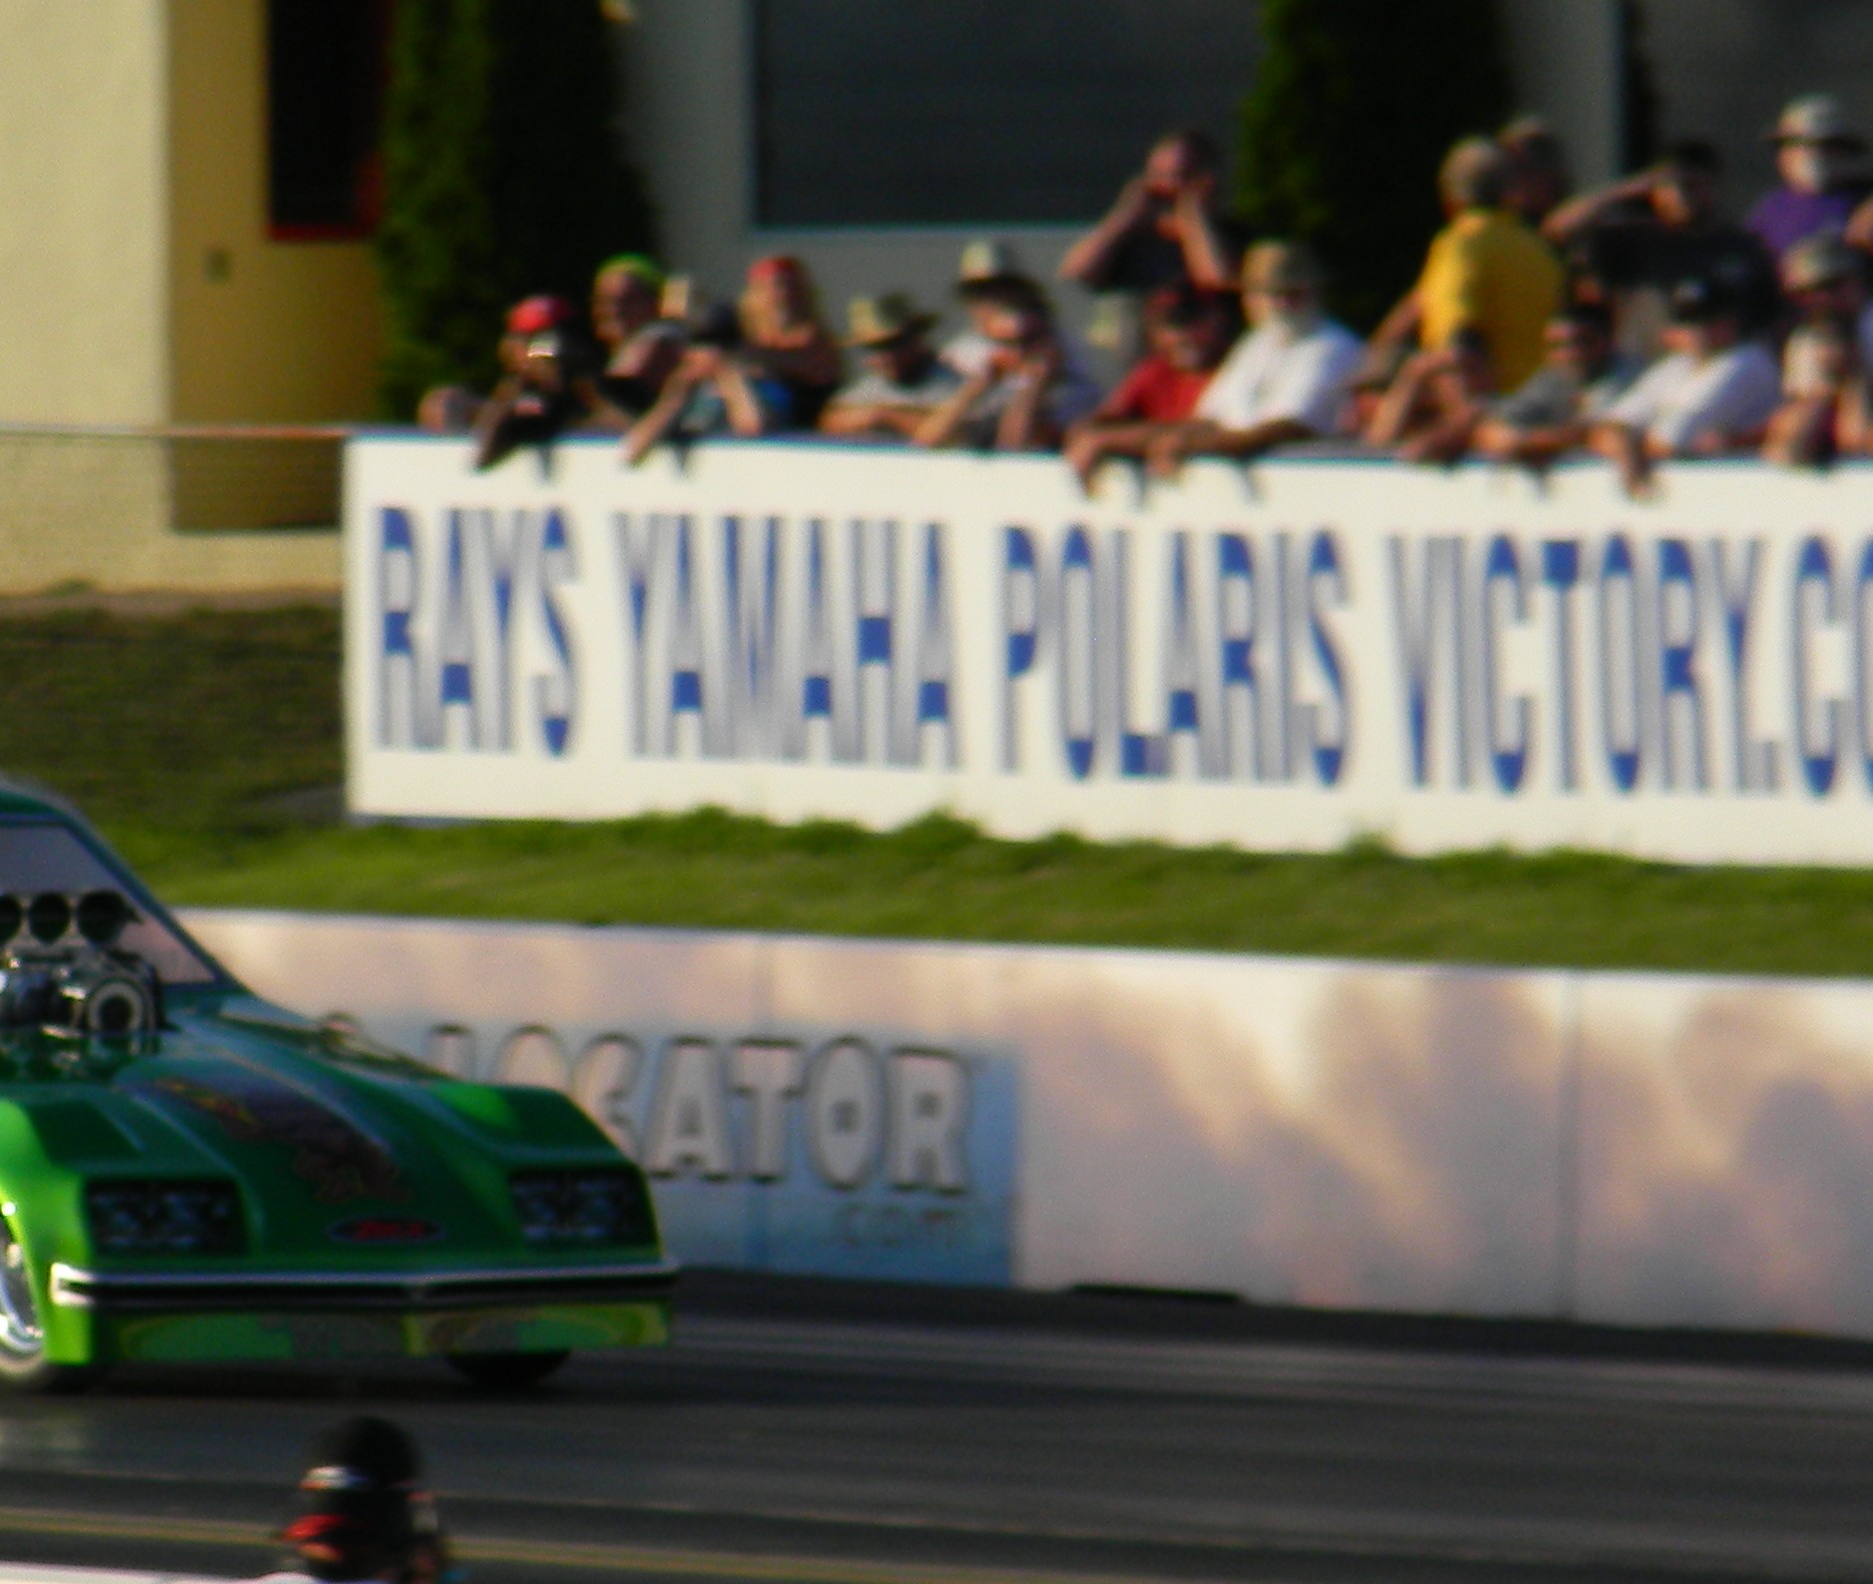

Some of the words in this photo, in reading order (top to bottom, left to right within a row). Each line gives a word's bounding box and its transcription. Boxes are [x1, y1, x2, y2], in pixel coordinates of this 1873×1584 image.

[375, 505, 582, 758] RAYS
[611, 510, 965, 770] YAMAHA
[997, 524, 1353, 788] POLARIS
